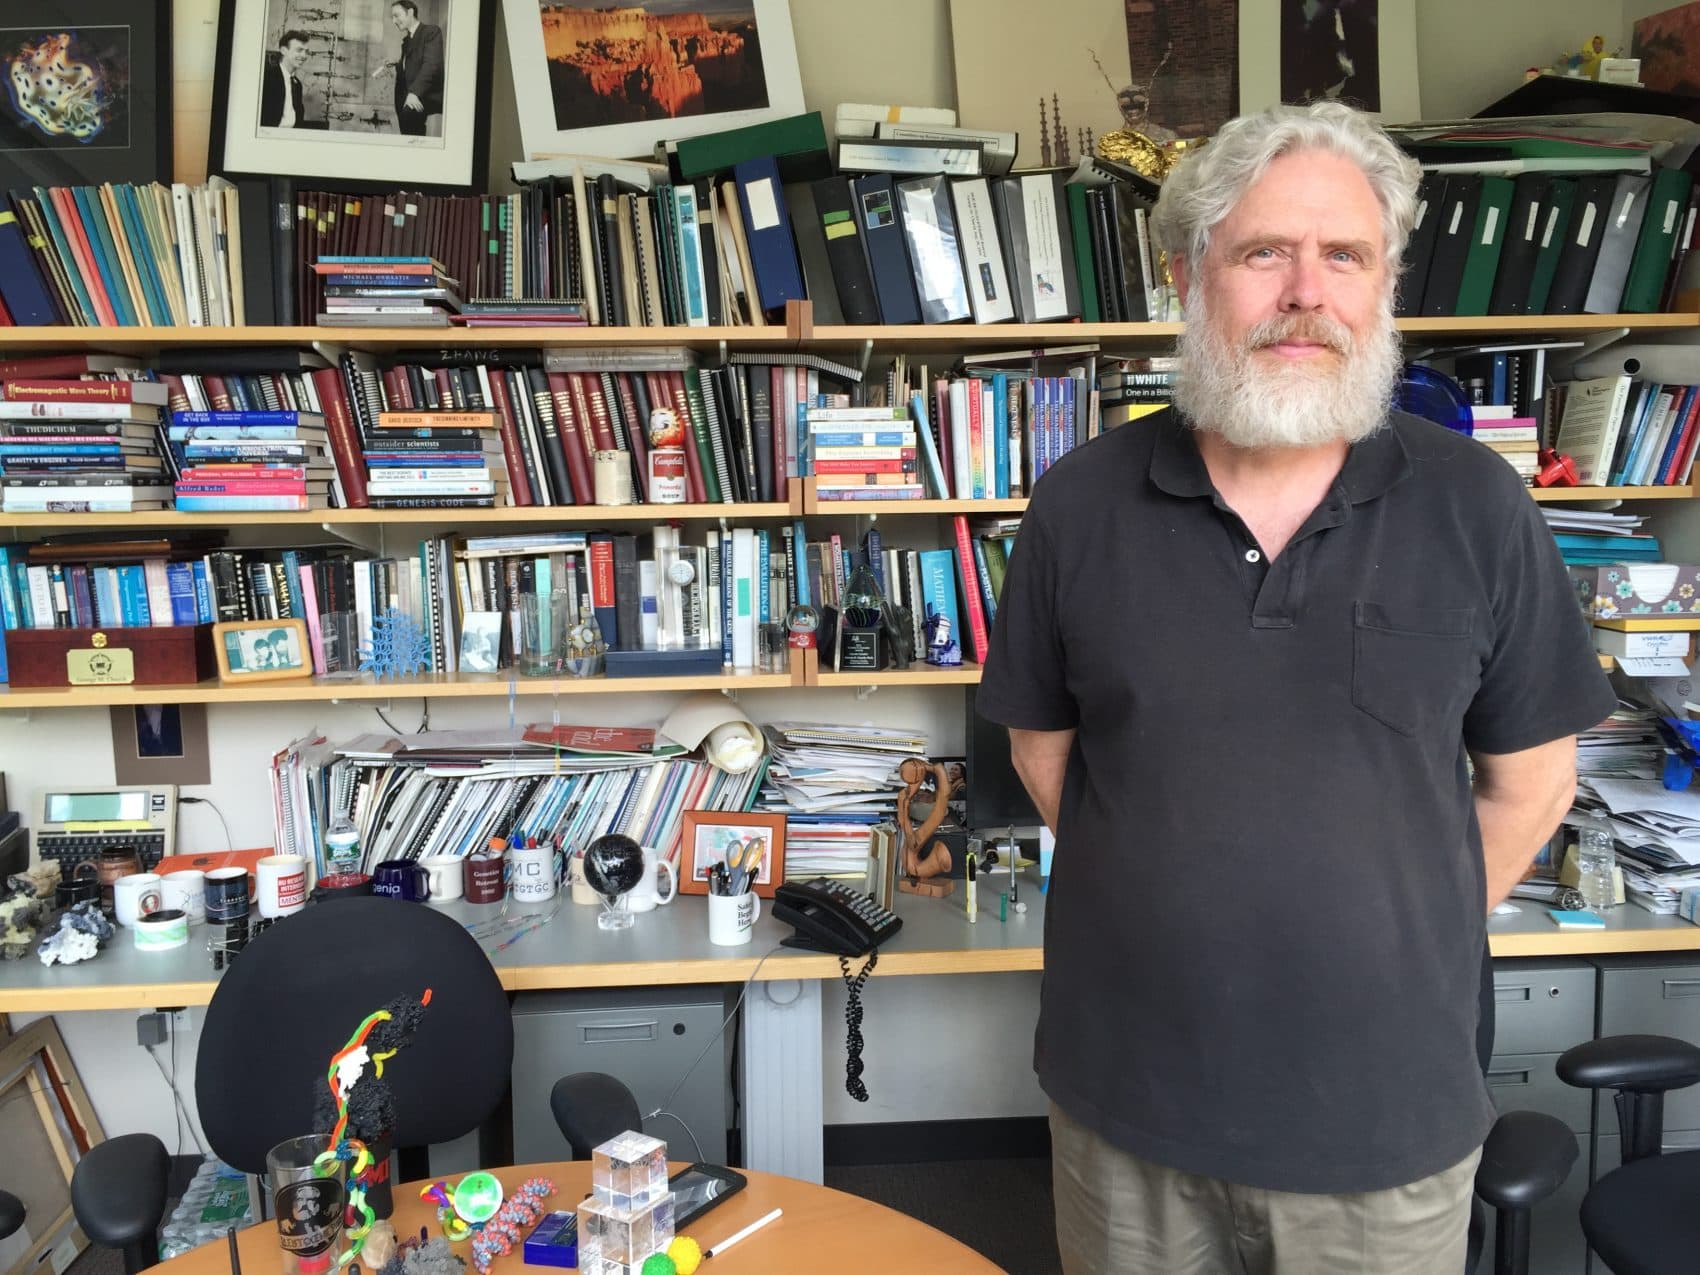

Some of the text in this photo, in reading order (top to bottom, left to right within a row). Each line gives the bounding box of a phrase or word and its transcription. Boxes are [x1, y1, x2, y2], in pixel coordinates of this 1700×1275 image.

[440, 350, 500, 361] ZHANG
[1135, 374, 1169, 385] WHITE
[14, 386, 68, 396] Electromagnetic
[87, 387, 110, 396] Theory
[1125, 389, 1142, 397] One
[1143, 389, 1150, 397] in
[1011, 395, 1020, 437] REGENESIS
[25, 425, 77, 433] THUDICHUM
[374, 439, 440, 448] outsider scientists
[440, 499, 464, 507] CODE
[274, 563, 285, 582] Jack
[759, 540, 769, 617] THE EVOLUTION OF
[979, 567, 993, 600] PLASTICS
[488, 561, 498, 612] Radiation Protecti
[931, 567, 946, 615] MATHEM
[277, 581, 290, 606] Welch
[726, 599, 732, 607] OF
